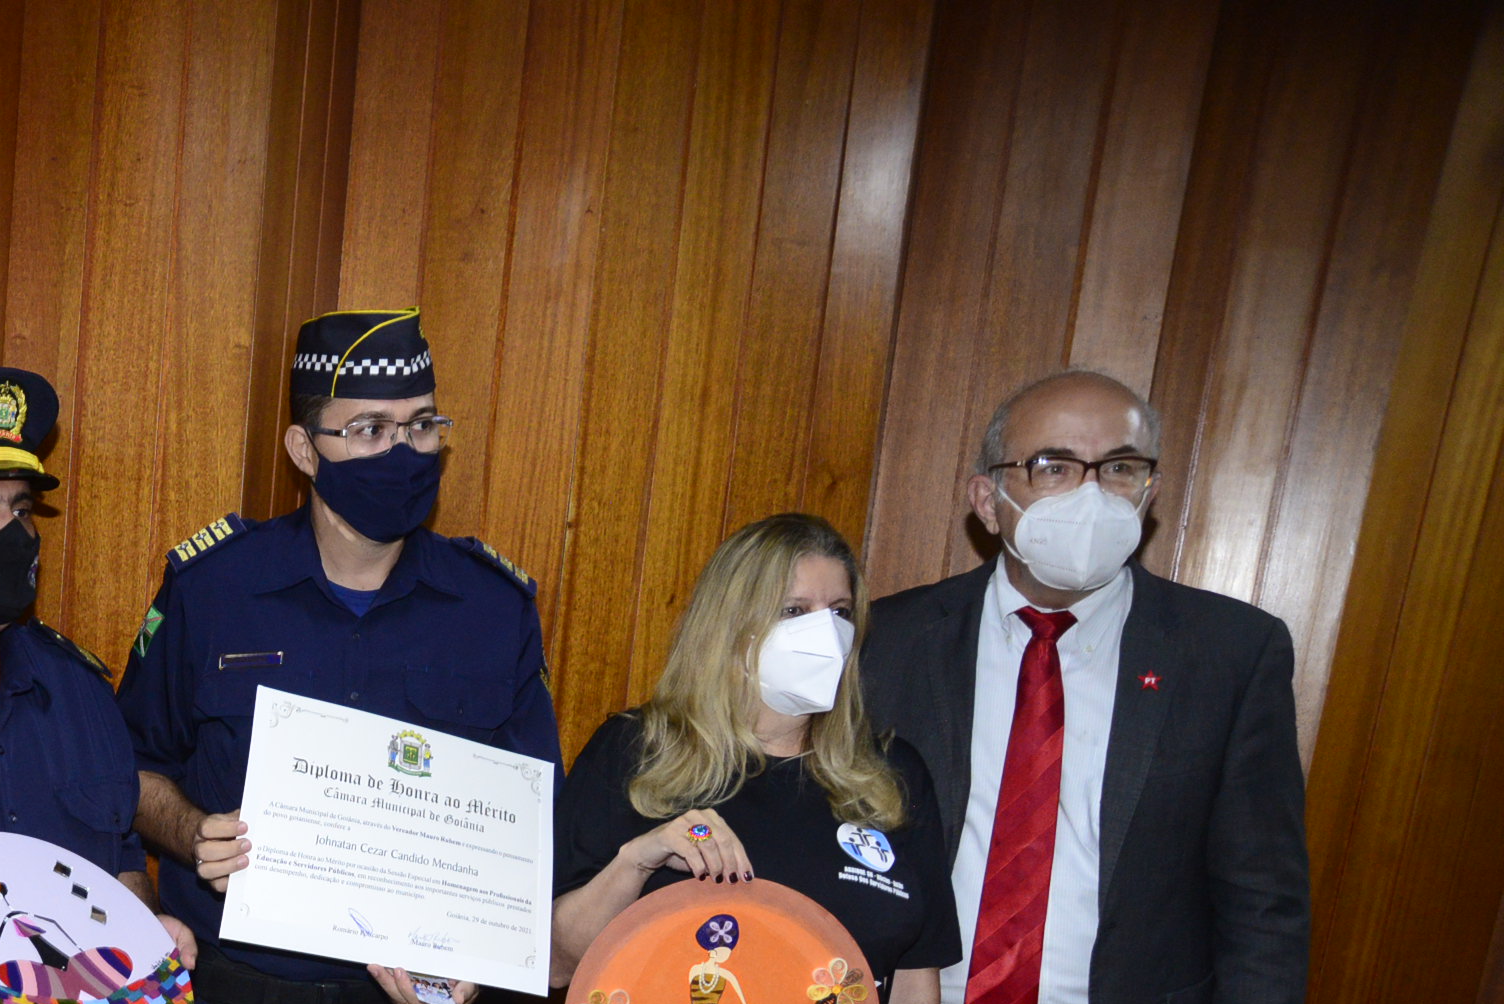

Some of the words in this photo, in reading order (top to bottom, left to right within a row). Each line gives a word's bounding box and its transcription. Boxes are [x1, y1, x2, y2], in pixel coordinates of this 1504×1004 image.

[1145, 677, 1156, 685] PT
[293, 757, 362, 786] Diploma
[367, 774, 384, 791] de
[390, 777, 439, 804] Honra
[444, 796, 461, 809] ao
[465, 799, 516, 824] Mérito
[323, 787, 367, 805] Câmara
[371, 797, 426, 819] Municipal
[429, 810, 441, 822] de
[443, 814, 485, 833] Goiânia
[315, 834, 357, 851] Johnatan
[360, 843, 387, 857] Cezar
[390, 849, 430, 865] Candido
[432, 857, 479, 877] Mendanha
